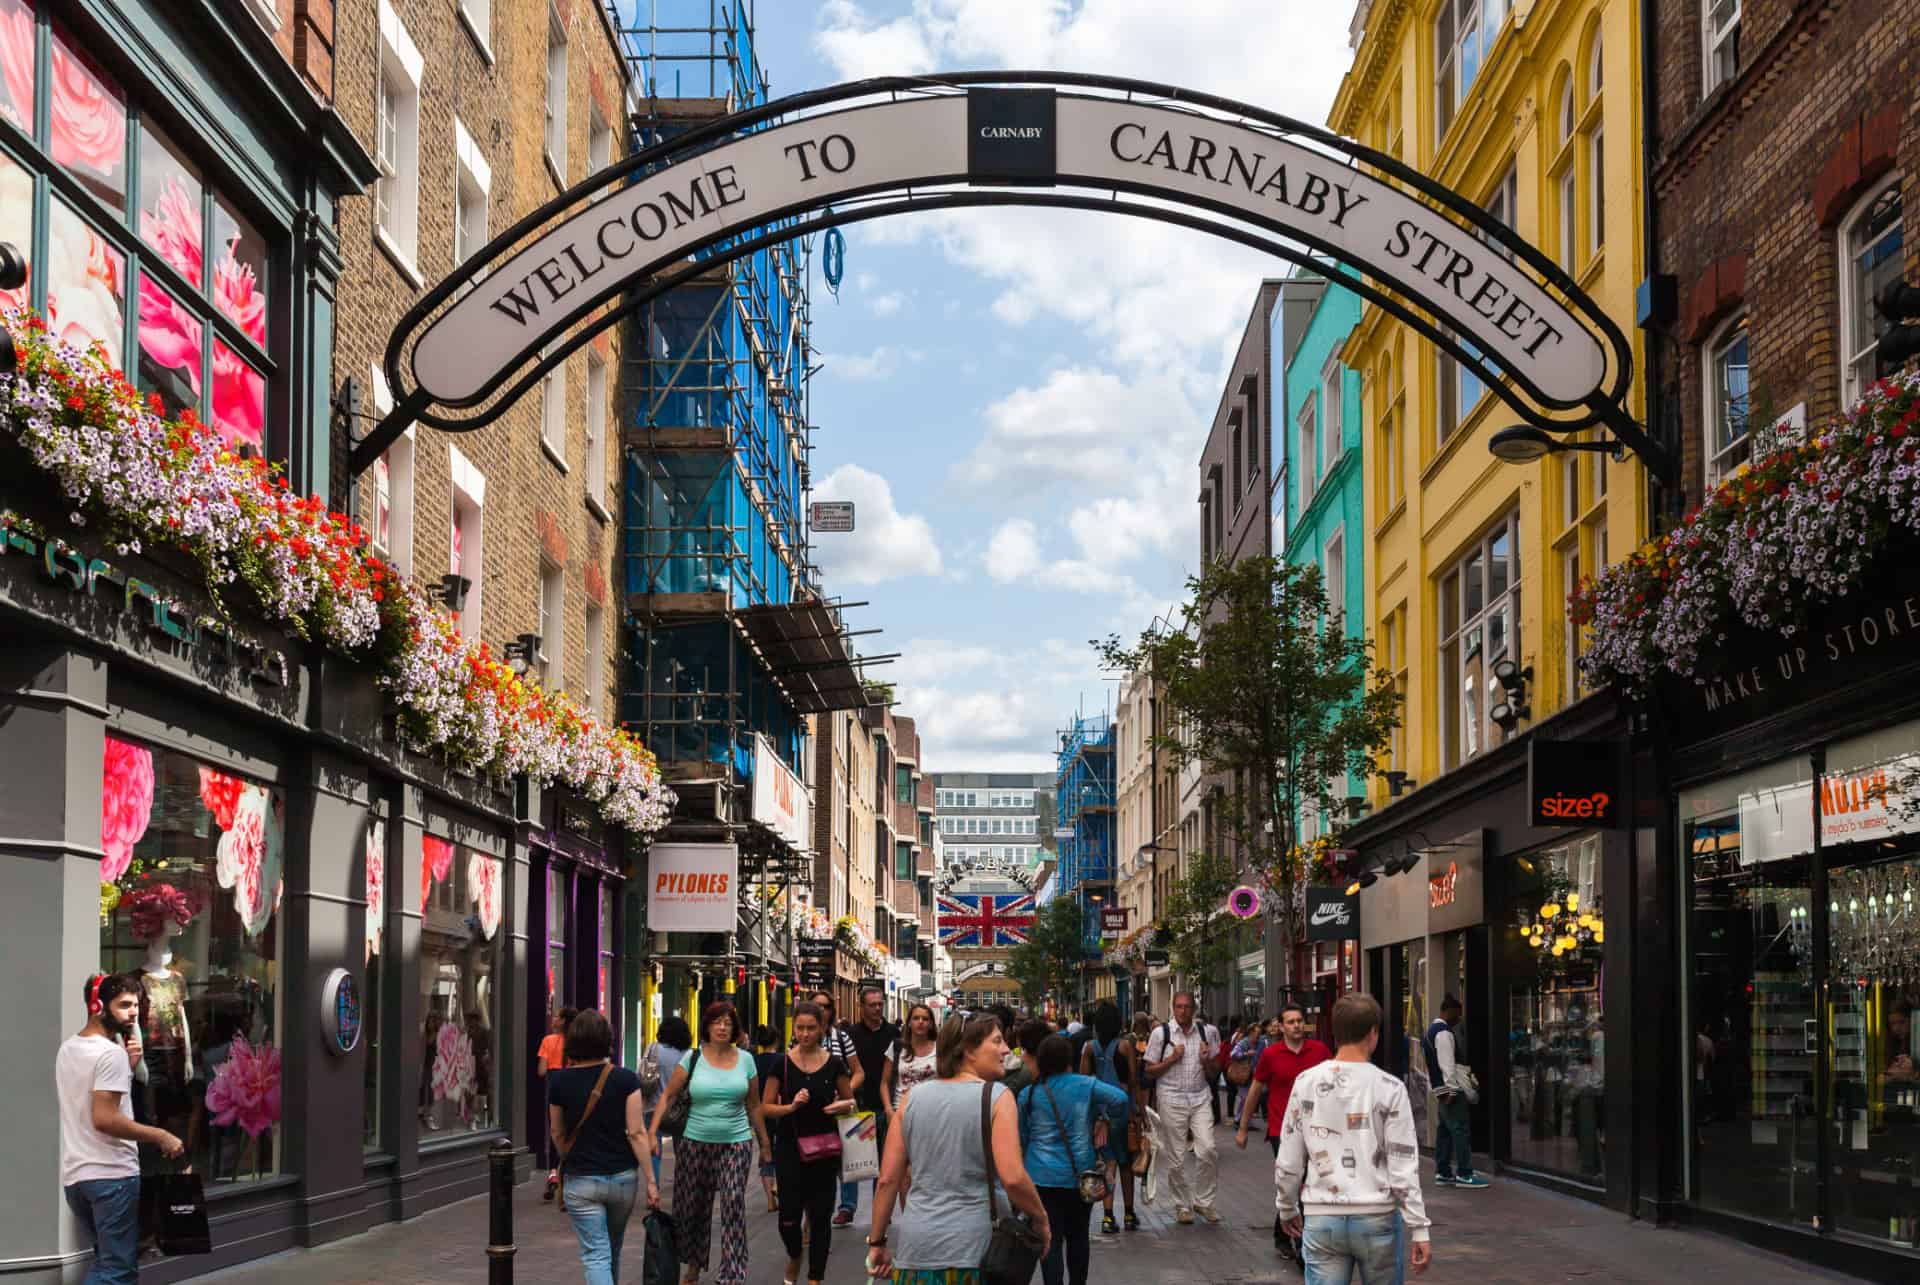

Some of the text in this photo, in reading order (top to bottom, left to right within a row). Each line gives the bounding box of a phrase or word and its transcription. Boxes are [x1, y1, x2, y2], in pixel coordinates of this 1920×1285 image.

[981, 126, 1043, 138] CARNABY
[489, 122, 1564, 360] WELCOME TO CARNABY STREET
[1704, 597, 1920, 712] MAKE UP STORE
[1541, 792, 1610, 817] size?
[655, 873, 729, 894] PYLONES
[1318, 902, 1345, 914] NIKE
